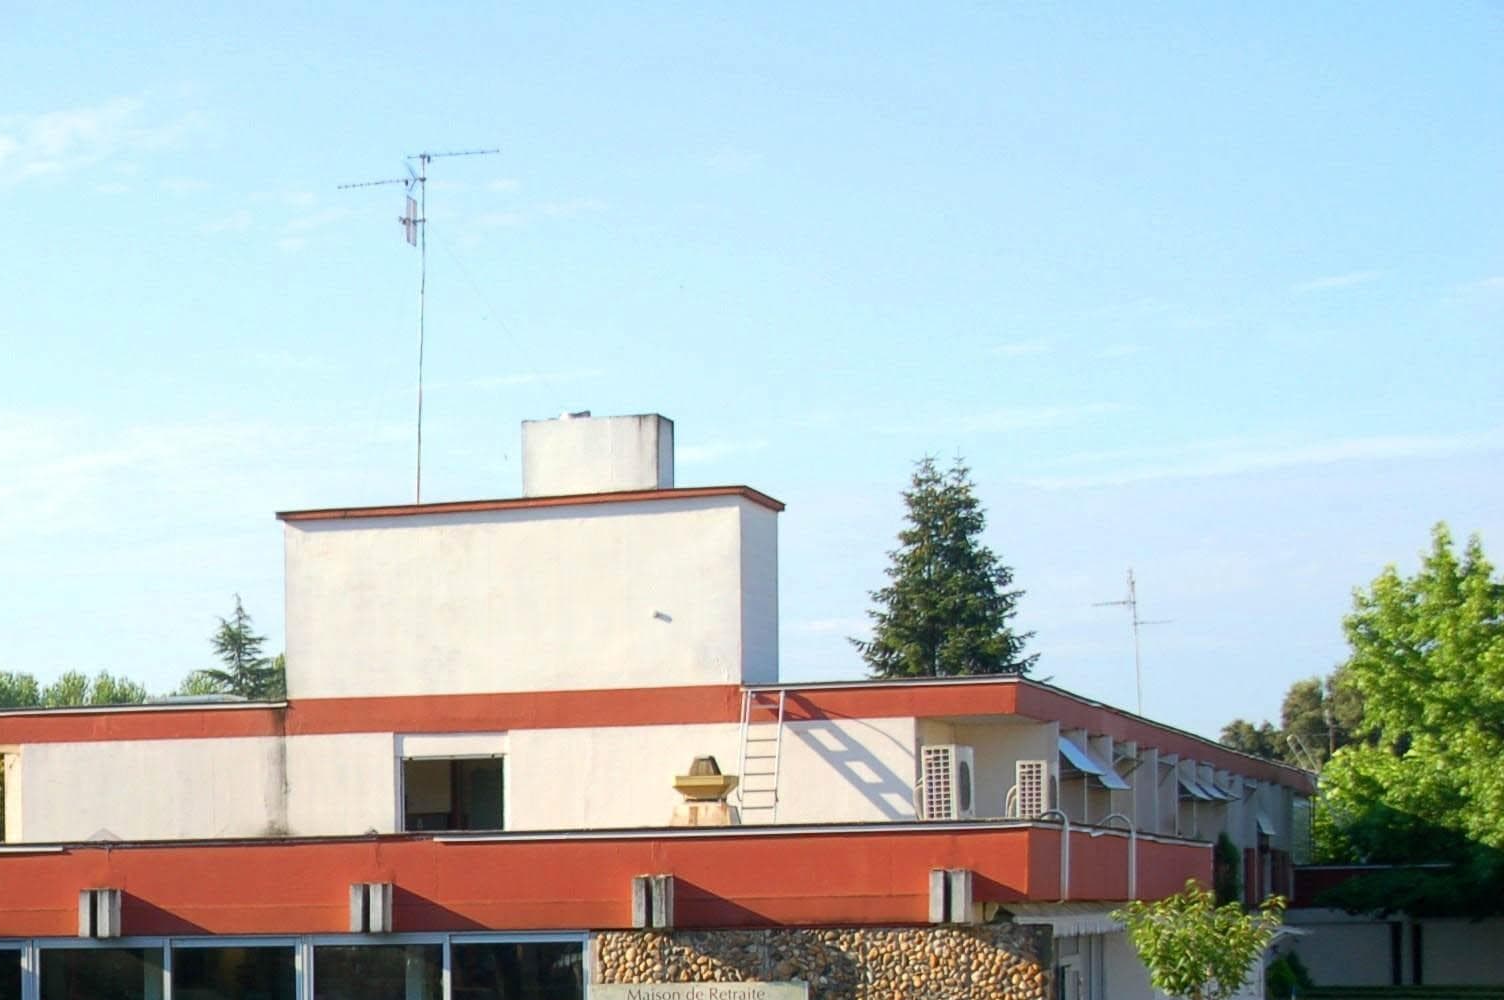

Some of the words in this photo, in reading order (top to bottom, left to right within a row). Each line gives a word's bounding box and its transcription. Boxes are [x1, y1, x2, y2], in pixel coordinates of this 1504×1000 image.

[627, 987, 680, 1000] Maison
[686, 987, 704, 1000] de
[709, 987, 765, 1000] Retraite
